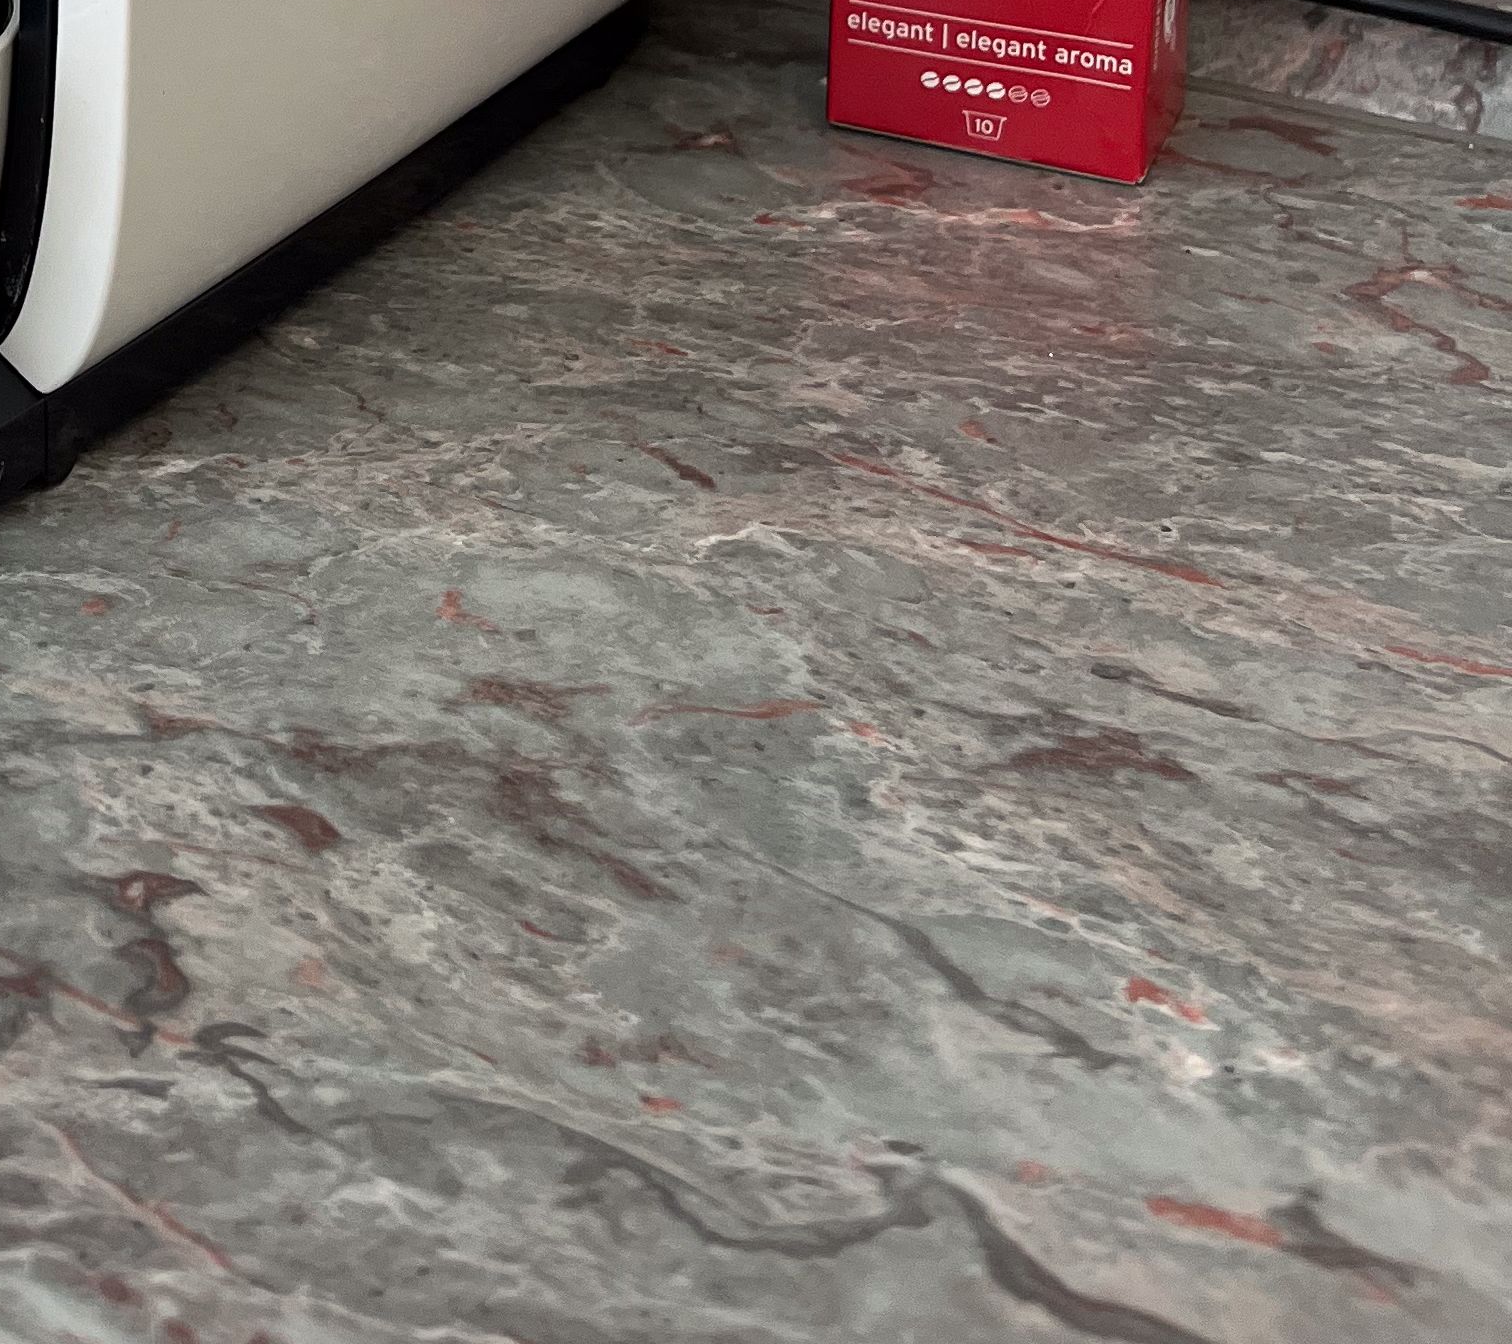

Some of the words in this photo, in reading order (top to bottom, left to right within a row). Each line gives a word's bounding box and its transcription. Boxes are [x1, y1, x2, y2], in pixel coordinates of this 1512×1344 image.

[847, 12, 934, 42] elegant
[956, 30, 1047, 58] elegant
[1055, 45, 1133, 75] aroma
[974, 118, 994, 134] 10
